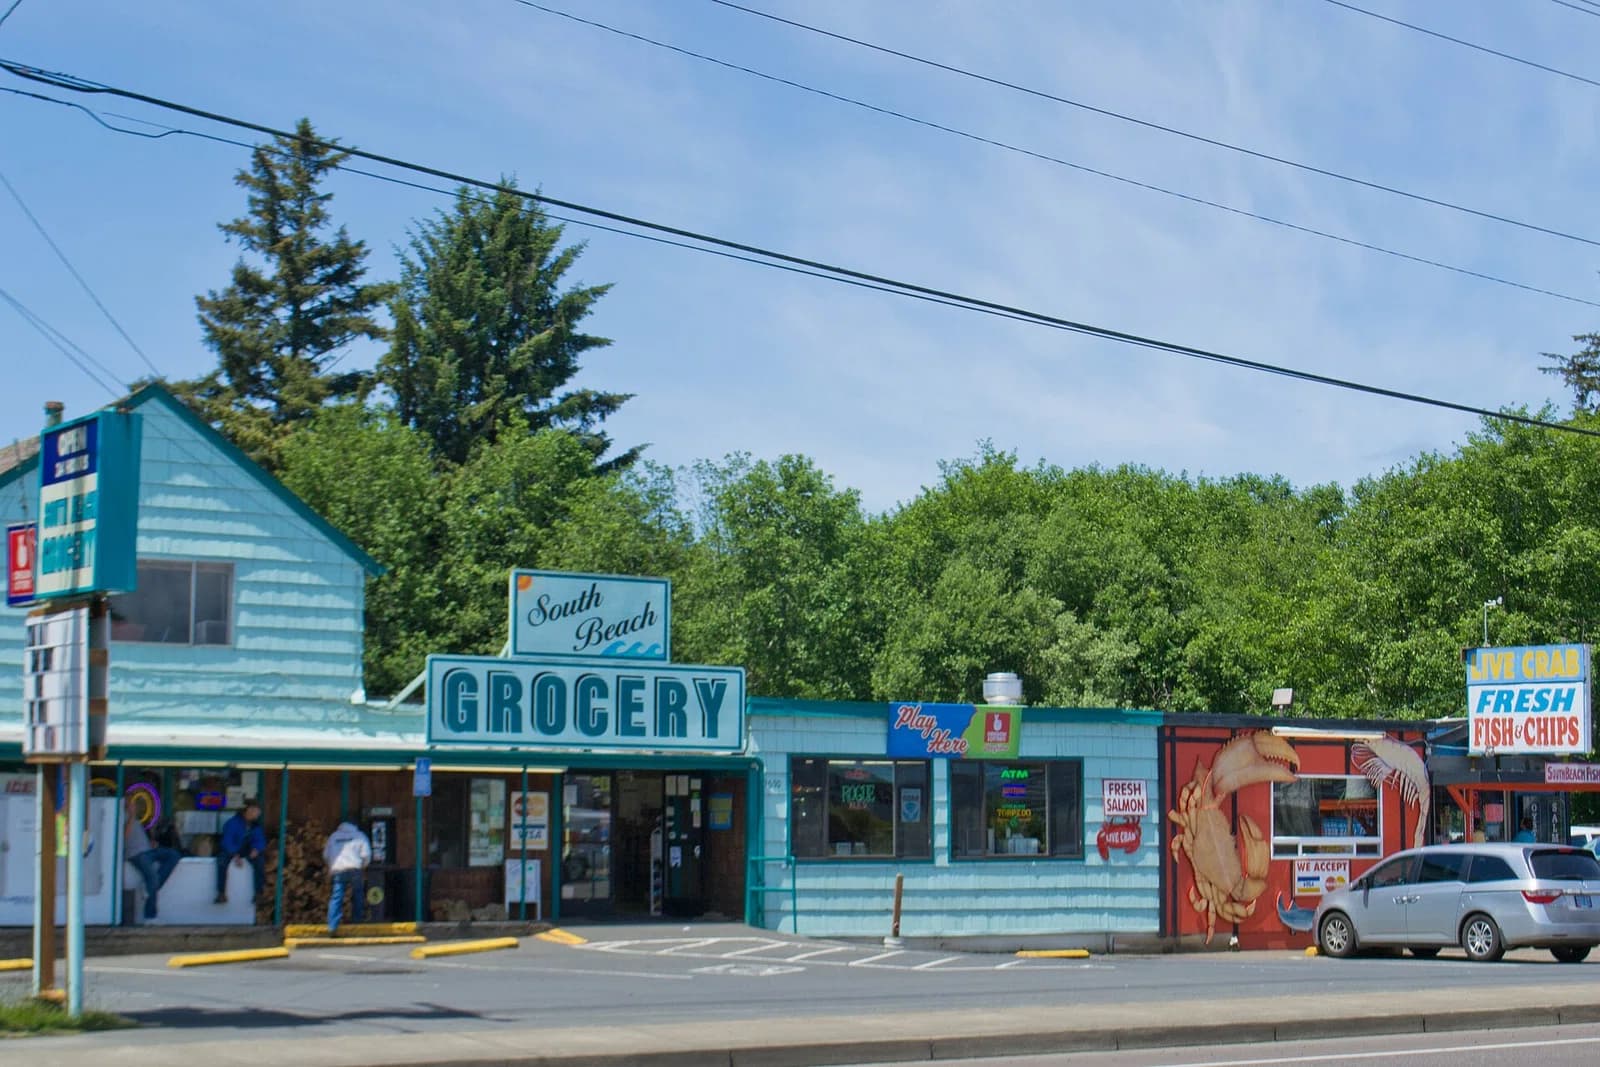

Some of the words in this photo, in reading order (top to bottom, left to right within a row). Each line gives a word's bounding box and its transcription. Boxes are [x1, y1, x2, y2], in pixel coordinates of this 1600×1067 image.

[527, 582, 604, 627] South
[573, 601, 658, 651] Beach
[1471, 652, 1515, 680] LIVE
[1522, 649, 1580, 678] CRAB
[441, 667, 728, 739] GROCERY
[1476, 688, 1576, 713] FRESH
[894, 705, 937, 739] Play
[927, 728, 968, 753] Here
[1000, 769, 1028, 779] ATM
[1108, 783, 1142, 796] FRESH
[1107, 798, 1144, 812] SALMON
[1297, 862, 1310, 872] WE
[1314, 862, 1347, 872] ACCEPT
